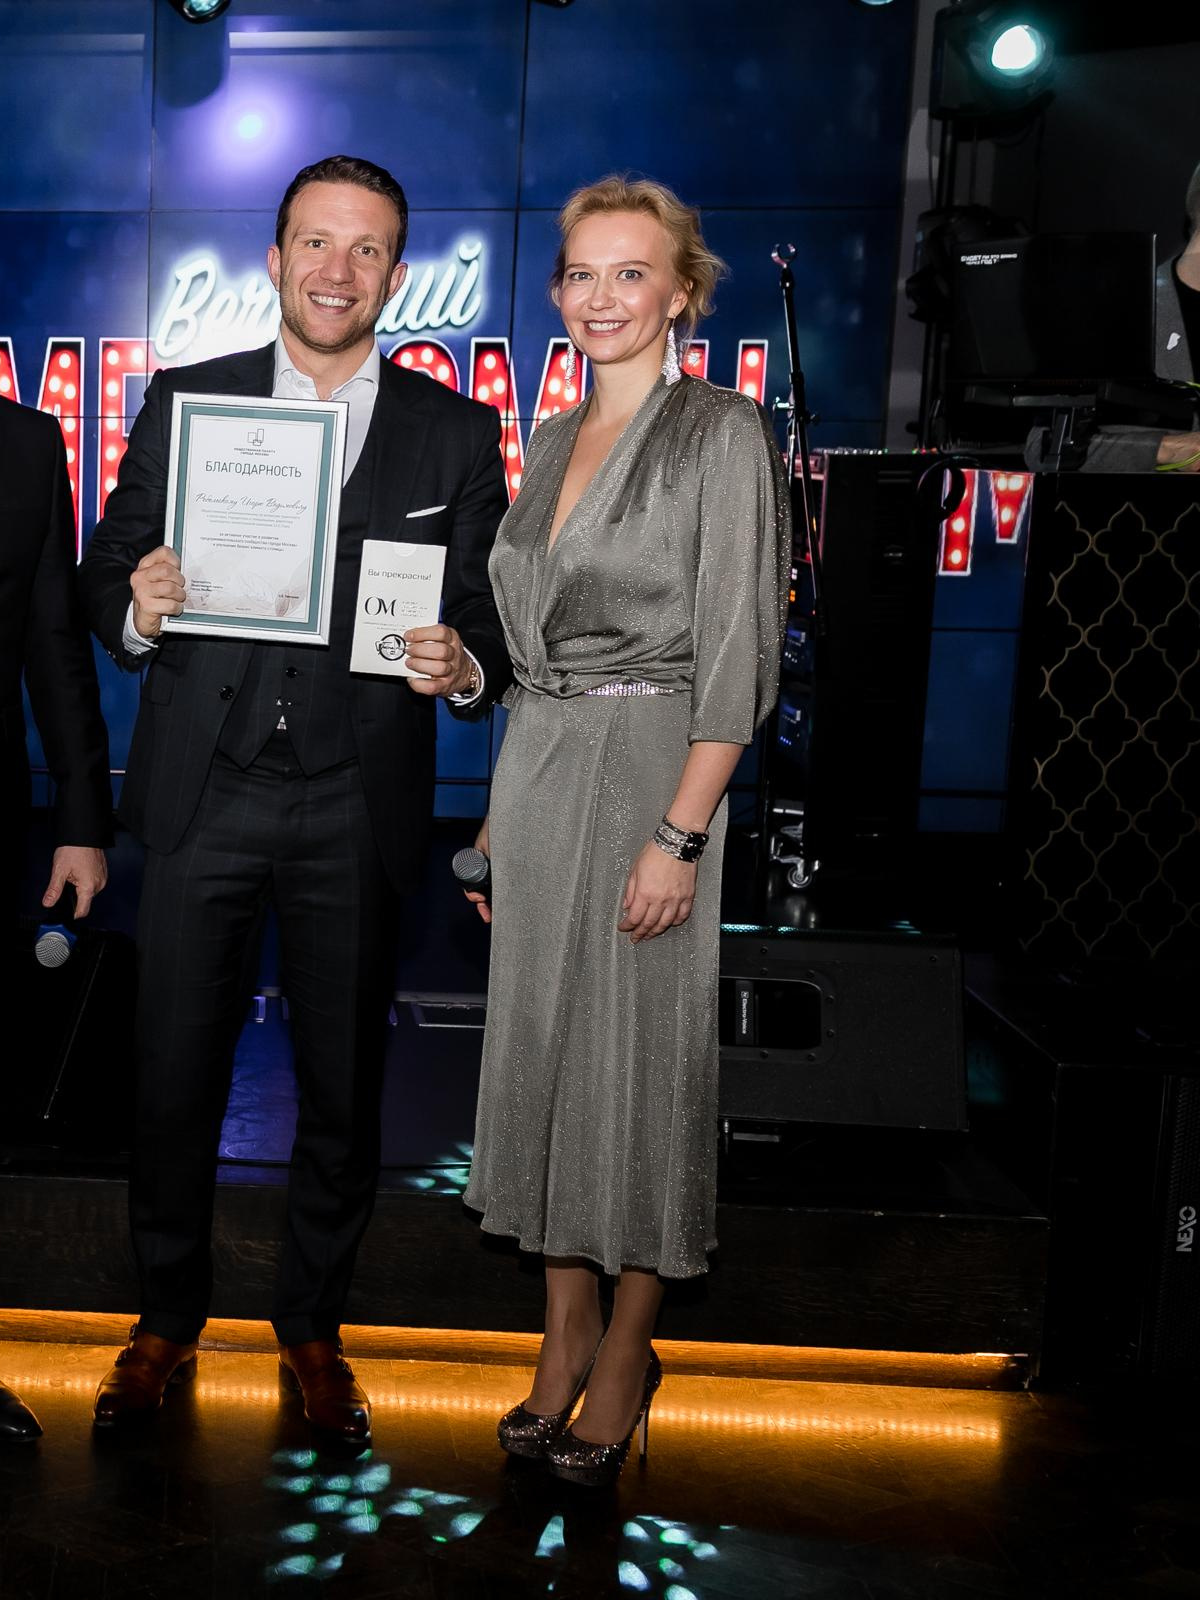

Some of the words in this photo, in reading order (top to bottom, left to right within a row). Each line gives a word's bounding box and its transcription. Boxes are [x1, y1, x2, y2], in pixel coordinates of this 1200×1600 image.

[205, 460, 302, 478] БЛАГОДАРНОСТЬ
[367, 568, 380, 576] Вы
[382, 570, 432, 581] прекрасны!
[1176, 1206, 1197, 1252] NEXO
